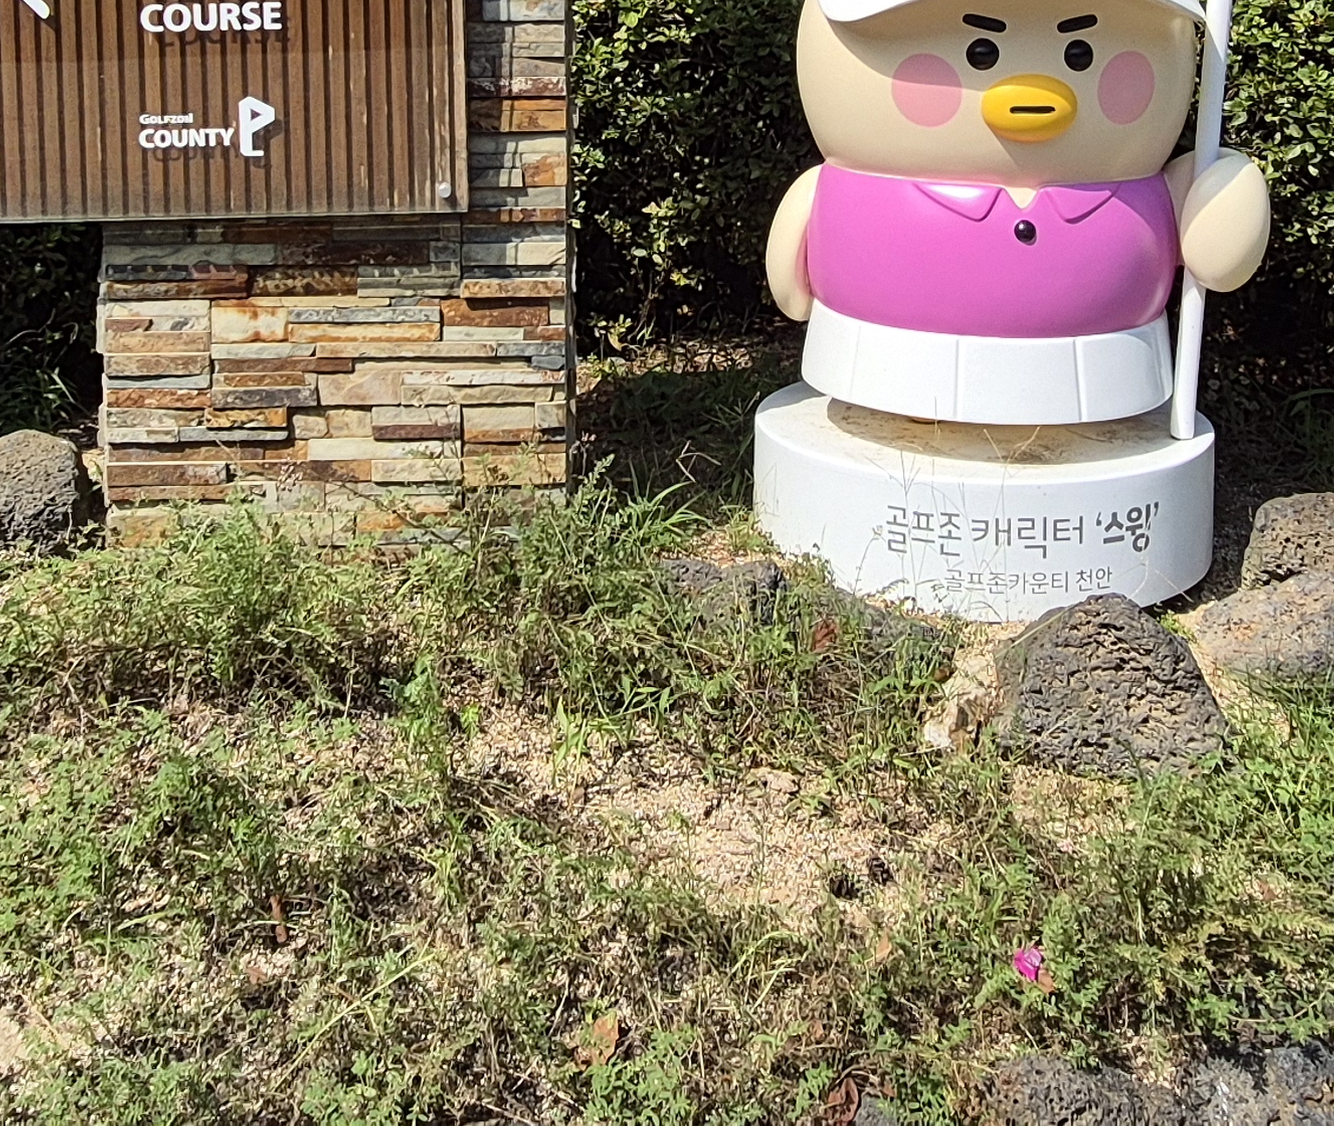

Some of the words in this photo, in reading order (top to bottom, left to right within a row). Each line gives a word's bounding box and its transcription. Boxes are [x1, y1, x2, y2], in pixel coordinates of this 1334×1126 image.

[139, 1, 283, 33] COURSE
[138, 128, 235, 149] COUNTY
[886, 505, 962, 557] 골프존
[971, 515, 1084, 560] 캐릭터
[944, 568, 1069, 595] 골프존카운티
[1075, 566, 1113, 592] 천안
